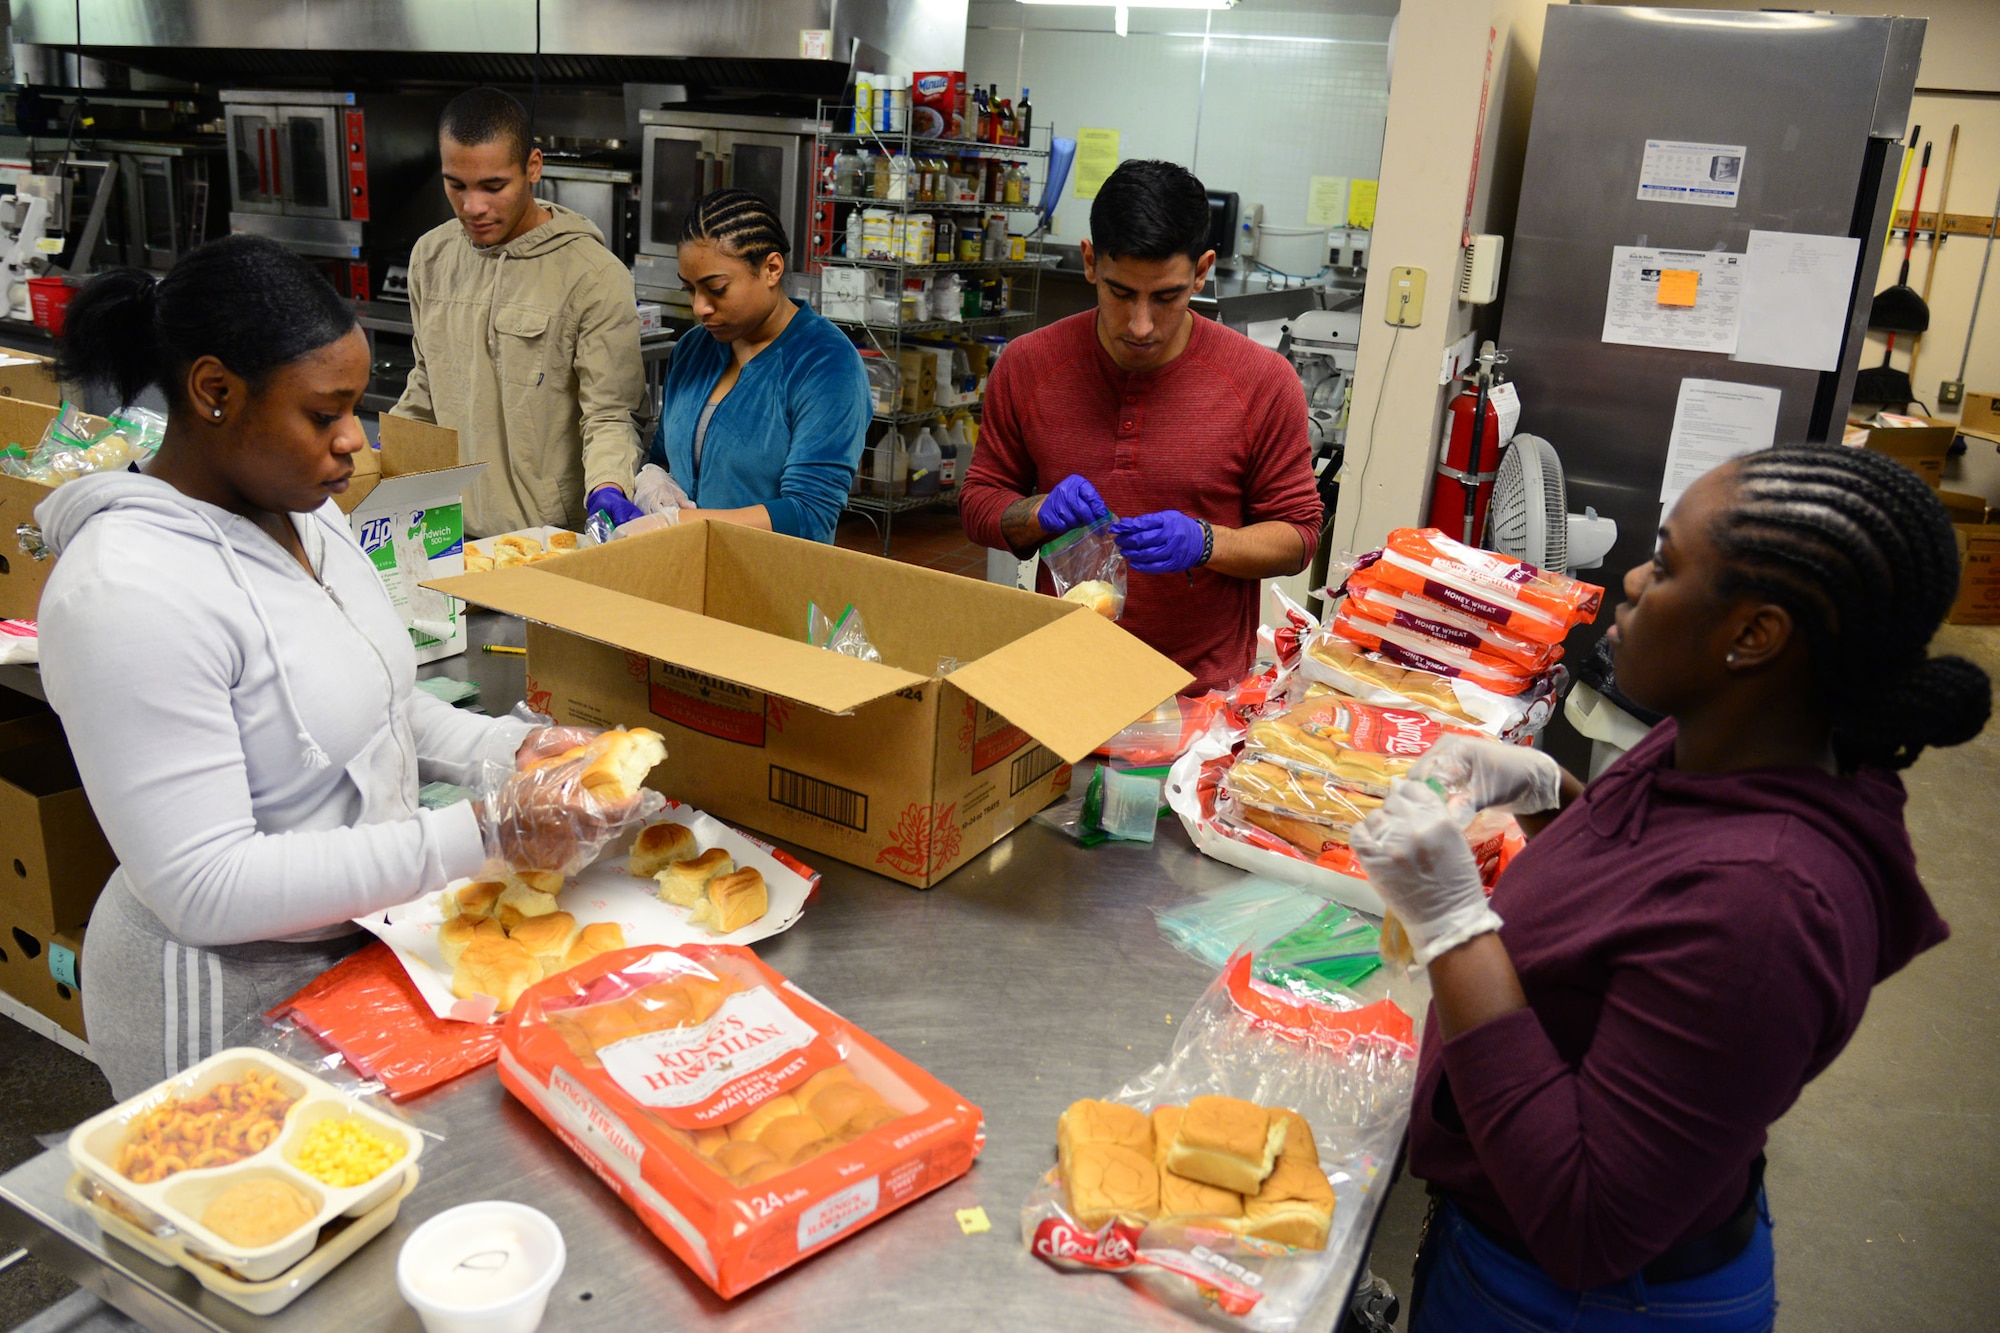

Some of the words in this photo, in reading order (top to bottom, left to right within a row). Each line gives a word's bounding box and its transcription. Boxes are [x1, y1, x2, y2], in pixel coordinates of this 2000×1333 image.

[919, 76, 949, 92] Minute
[431, 536, 443, 546] 500
[1444, 589, 1470, 606] HONEY
[1472, 600, 1497, 615] WHEAT
[1461, 602, 1476, 613] ROLLS
[1415, 618, 1441, 634] HONEY
[1442, 626, 1468, 639] WHEAT
[1432, 631, 1447, 639] ROLLS
[1425, 658, 1448, 672] WHEAT
[983, 799, 1000, 815] TRAYS
[656, 1014, 744, 1068] KING'S
[642, 1023, 786, 1092] HAWAIIAN
[694, 1082, 766, 1121] HAWAIIAN
[766, 1056, 808, 1087] SWEET
[722, 1070, 772, 1097] ORIGINAL
[745, 1085, 780, 1106] ROLLS
[554, 1074, 589, 1113] KING'S
[588, 1106, 641, 1163] HAWAIIAN
[751, 1190, 784, 1218] 24
[783, 1188, 809, 1204] Rolls
[818, 1194, 861, 1220] KING'S
[807, 1197, 872, 1237] HAWAIIAN
